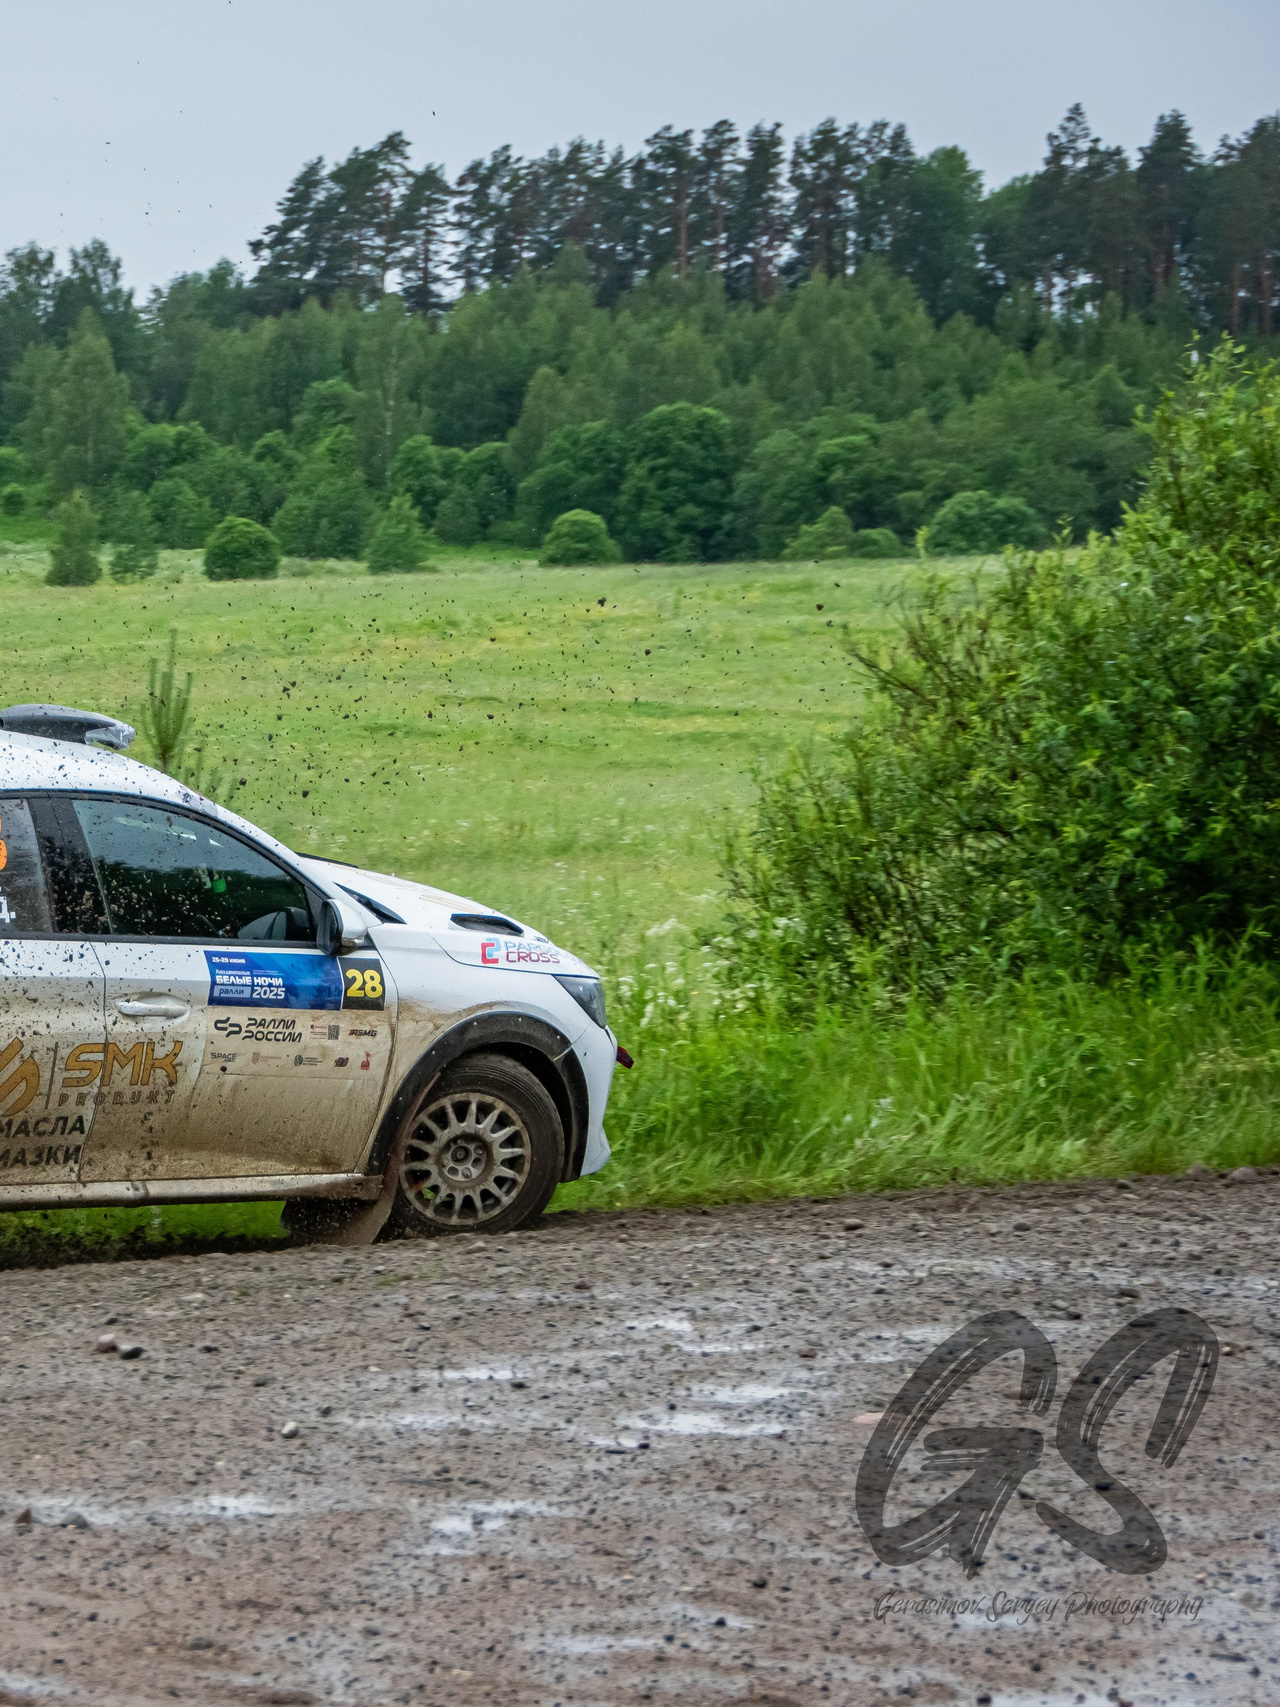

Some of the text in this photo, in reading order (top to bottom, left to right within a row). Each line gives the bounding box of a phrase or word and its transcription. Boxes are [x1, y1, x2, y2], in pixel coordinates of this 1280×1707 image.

[506, 951, 560, 964] CROSS
[216, 975, 283, 987] БЕЛЫЕ НОЧИ
[345, 968, 383, 999] 28
[252, 986, 286, 999] 2025
[246, 1018, 296, 1030] РАЛЛИ
[242, 1030, 303, 1043] РОССИИ
[210, 1052, 238, 1060] SPACE
[62, 1041, 183, 1087] SMK
